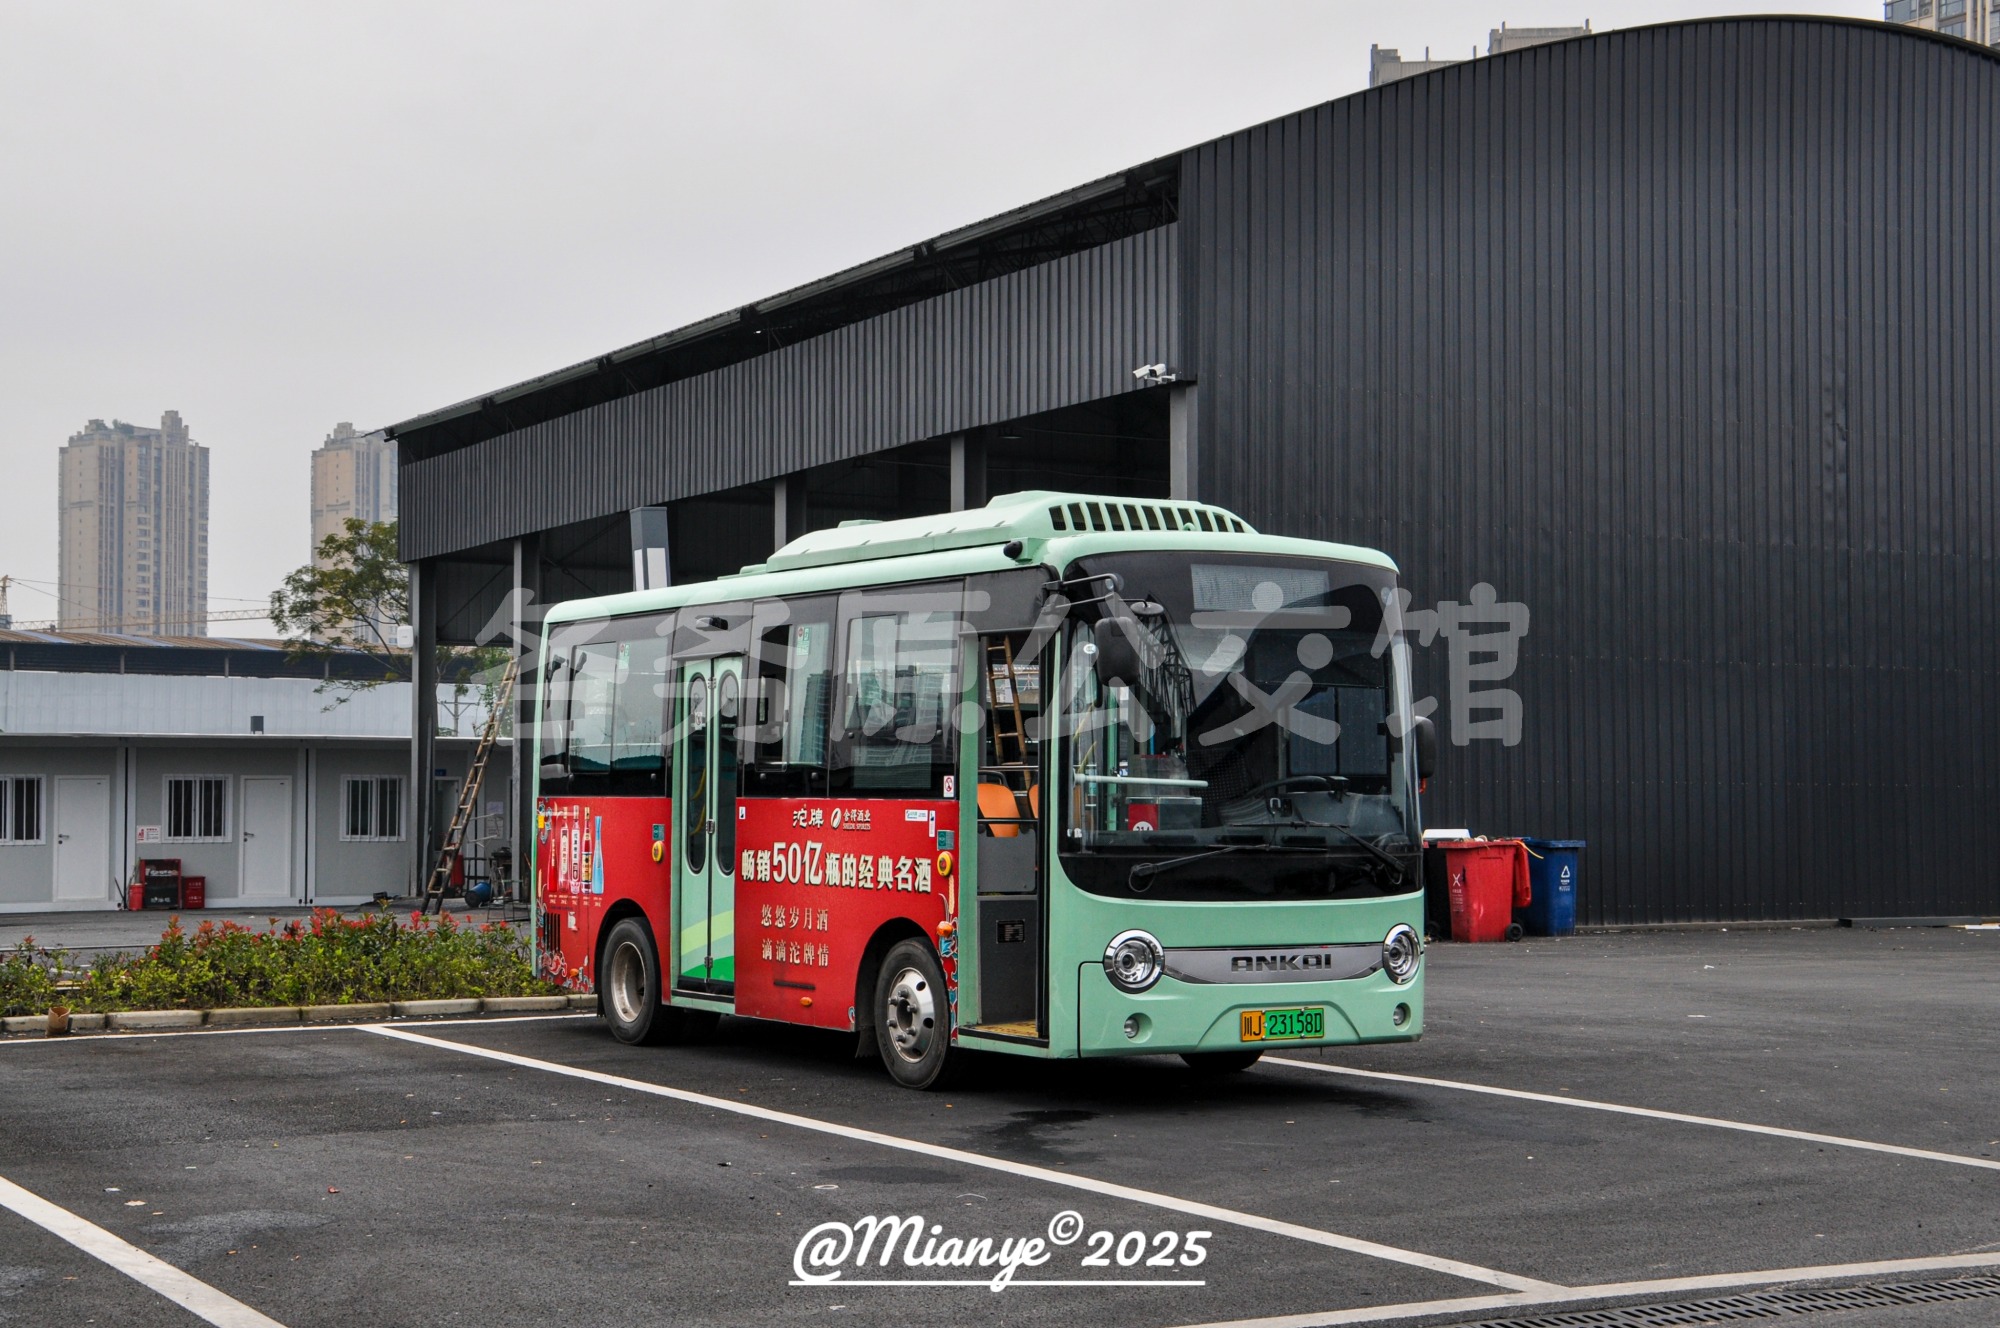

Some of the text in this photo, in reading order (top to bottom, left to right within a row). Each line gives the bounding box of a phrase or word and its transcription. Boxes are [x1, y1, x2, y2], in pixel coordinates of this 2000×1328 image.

[793, 807, 824, 829] 沱牌
[741, 840, 932, 893] 畅销50亿瓶的经典名酒
[761, 904, 828, 931] 悠悠岁月酒
[762, 938, 829, 967] 滴滴沱牌情
[1231, 953, 1332, 972] ANKAI
[1269, 1012, 1323, 1035] 23158D
